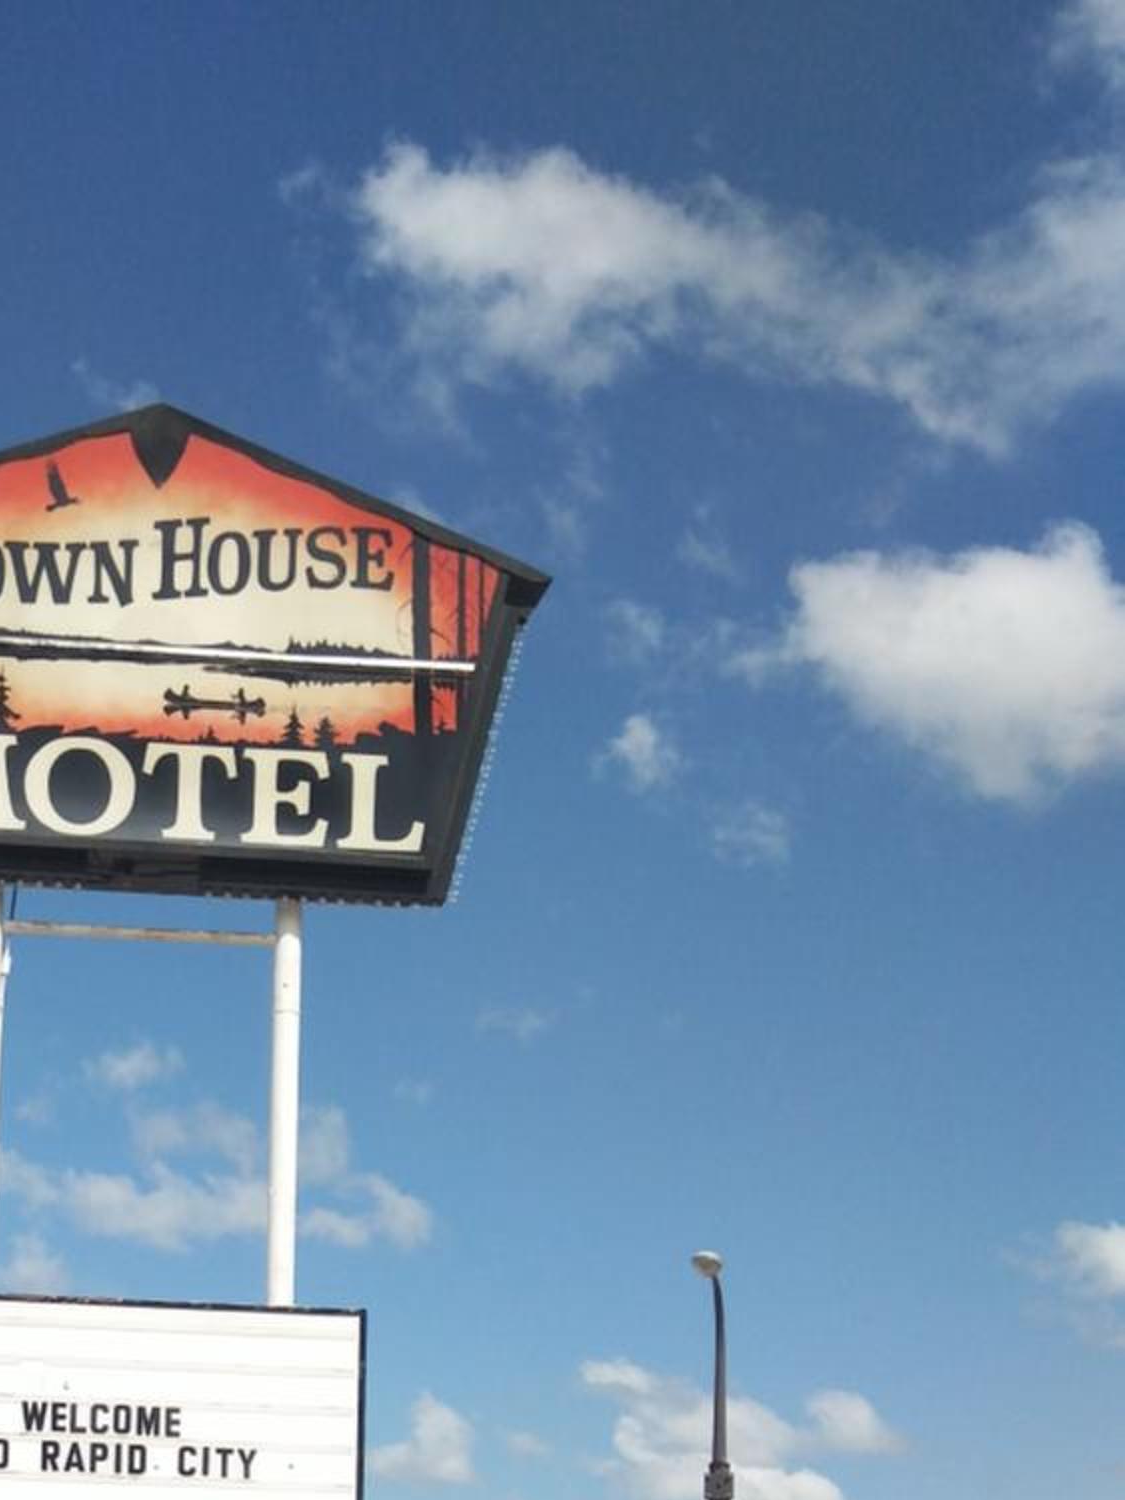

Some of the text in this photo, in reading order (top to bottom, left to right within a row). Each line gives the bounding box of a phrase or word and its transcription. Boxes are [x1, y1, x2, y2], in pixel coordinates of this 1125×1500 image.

[151, 517, 394, 599] HOUSE
[21, 1401, 182, 1437] WELCOME
[40, 1441, 147, 1475] RAPID
[177, 1446, 257, 1479] CITY
